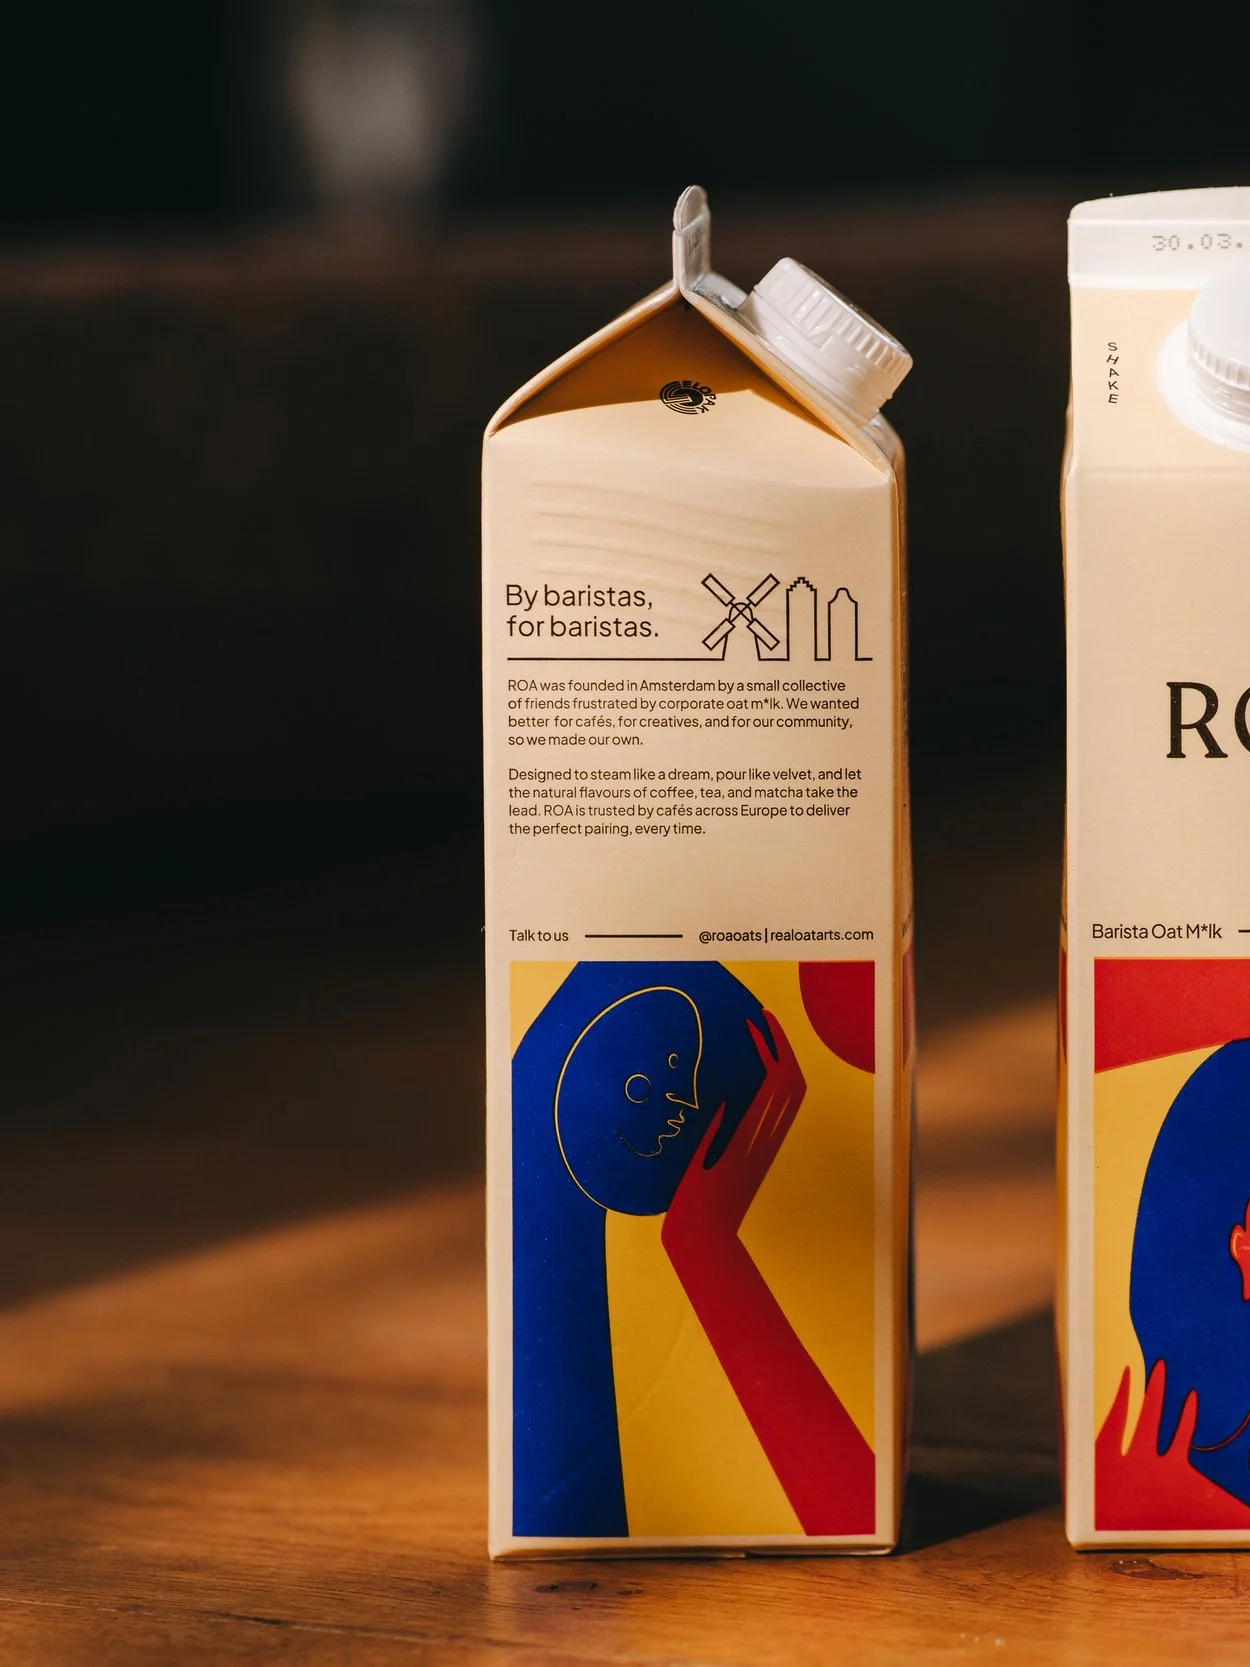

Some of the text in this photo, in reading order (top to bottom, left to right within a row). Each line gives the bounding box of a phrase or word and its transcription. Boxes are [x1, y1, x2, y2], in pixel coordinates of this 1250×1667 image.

[1106, 341, 1120, 404] SHAKE
[681, 380, 717, 414] ELOPAK
[506, 584, 652, 612] By baristas,
[506, 615, 658, 637] for baristas.
[508, 679, 846, 694] ROA was founded in Amsterdam by a small collective
[508, 697, 522, 709] of
[524, 697, 570, 709] friends
[572, 697, 637, 709] frustrated
[640, 697, 657, 712] by
[659, 699, 724, 712] corporate
[726, 699, 749, 710] oat
[786, 697, 808, 710] We
[809, 697, 859, 710] wanted
[508, 715, 853, 730] better for cafés, for creatives, and for our community,
[508, 733, 643, 746] so we made our own.
[509, 767, 862, 783] Designed to steam like a dream, pour like velvet, and let
[508, 786, 858, 799] the natural flavours of coffee, tea, and matcha take the
[509, 804, 851, 819] lead. ROA is trusted by cafés across Europe to deliver
[509, 822, 706, 837] the perfect pairing, every time.
[509, 929, 569, 942] Talk to us
[699, 930, 762, 944] @roaoats
[770, 929, 874, 941] realoatarts.com
[1092, 923, 1148, 939] Barista
[1151, 923, 1183, 939] Oat
